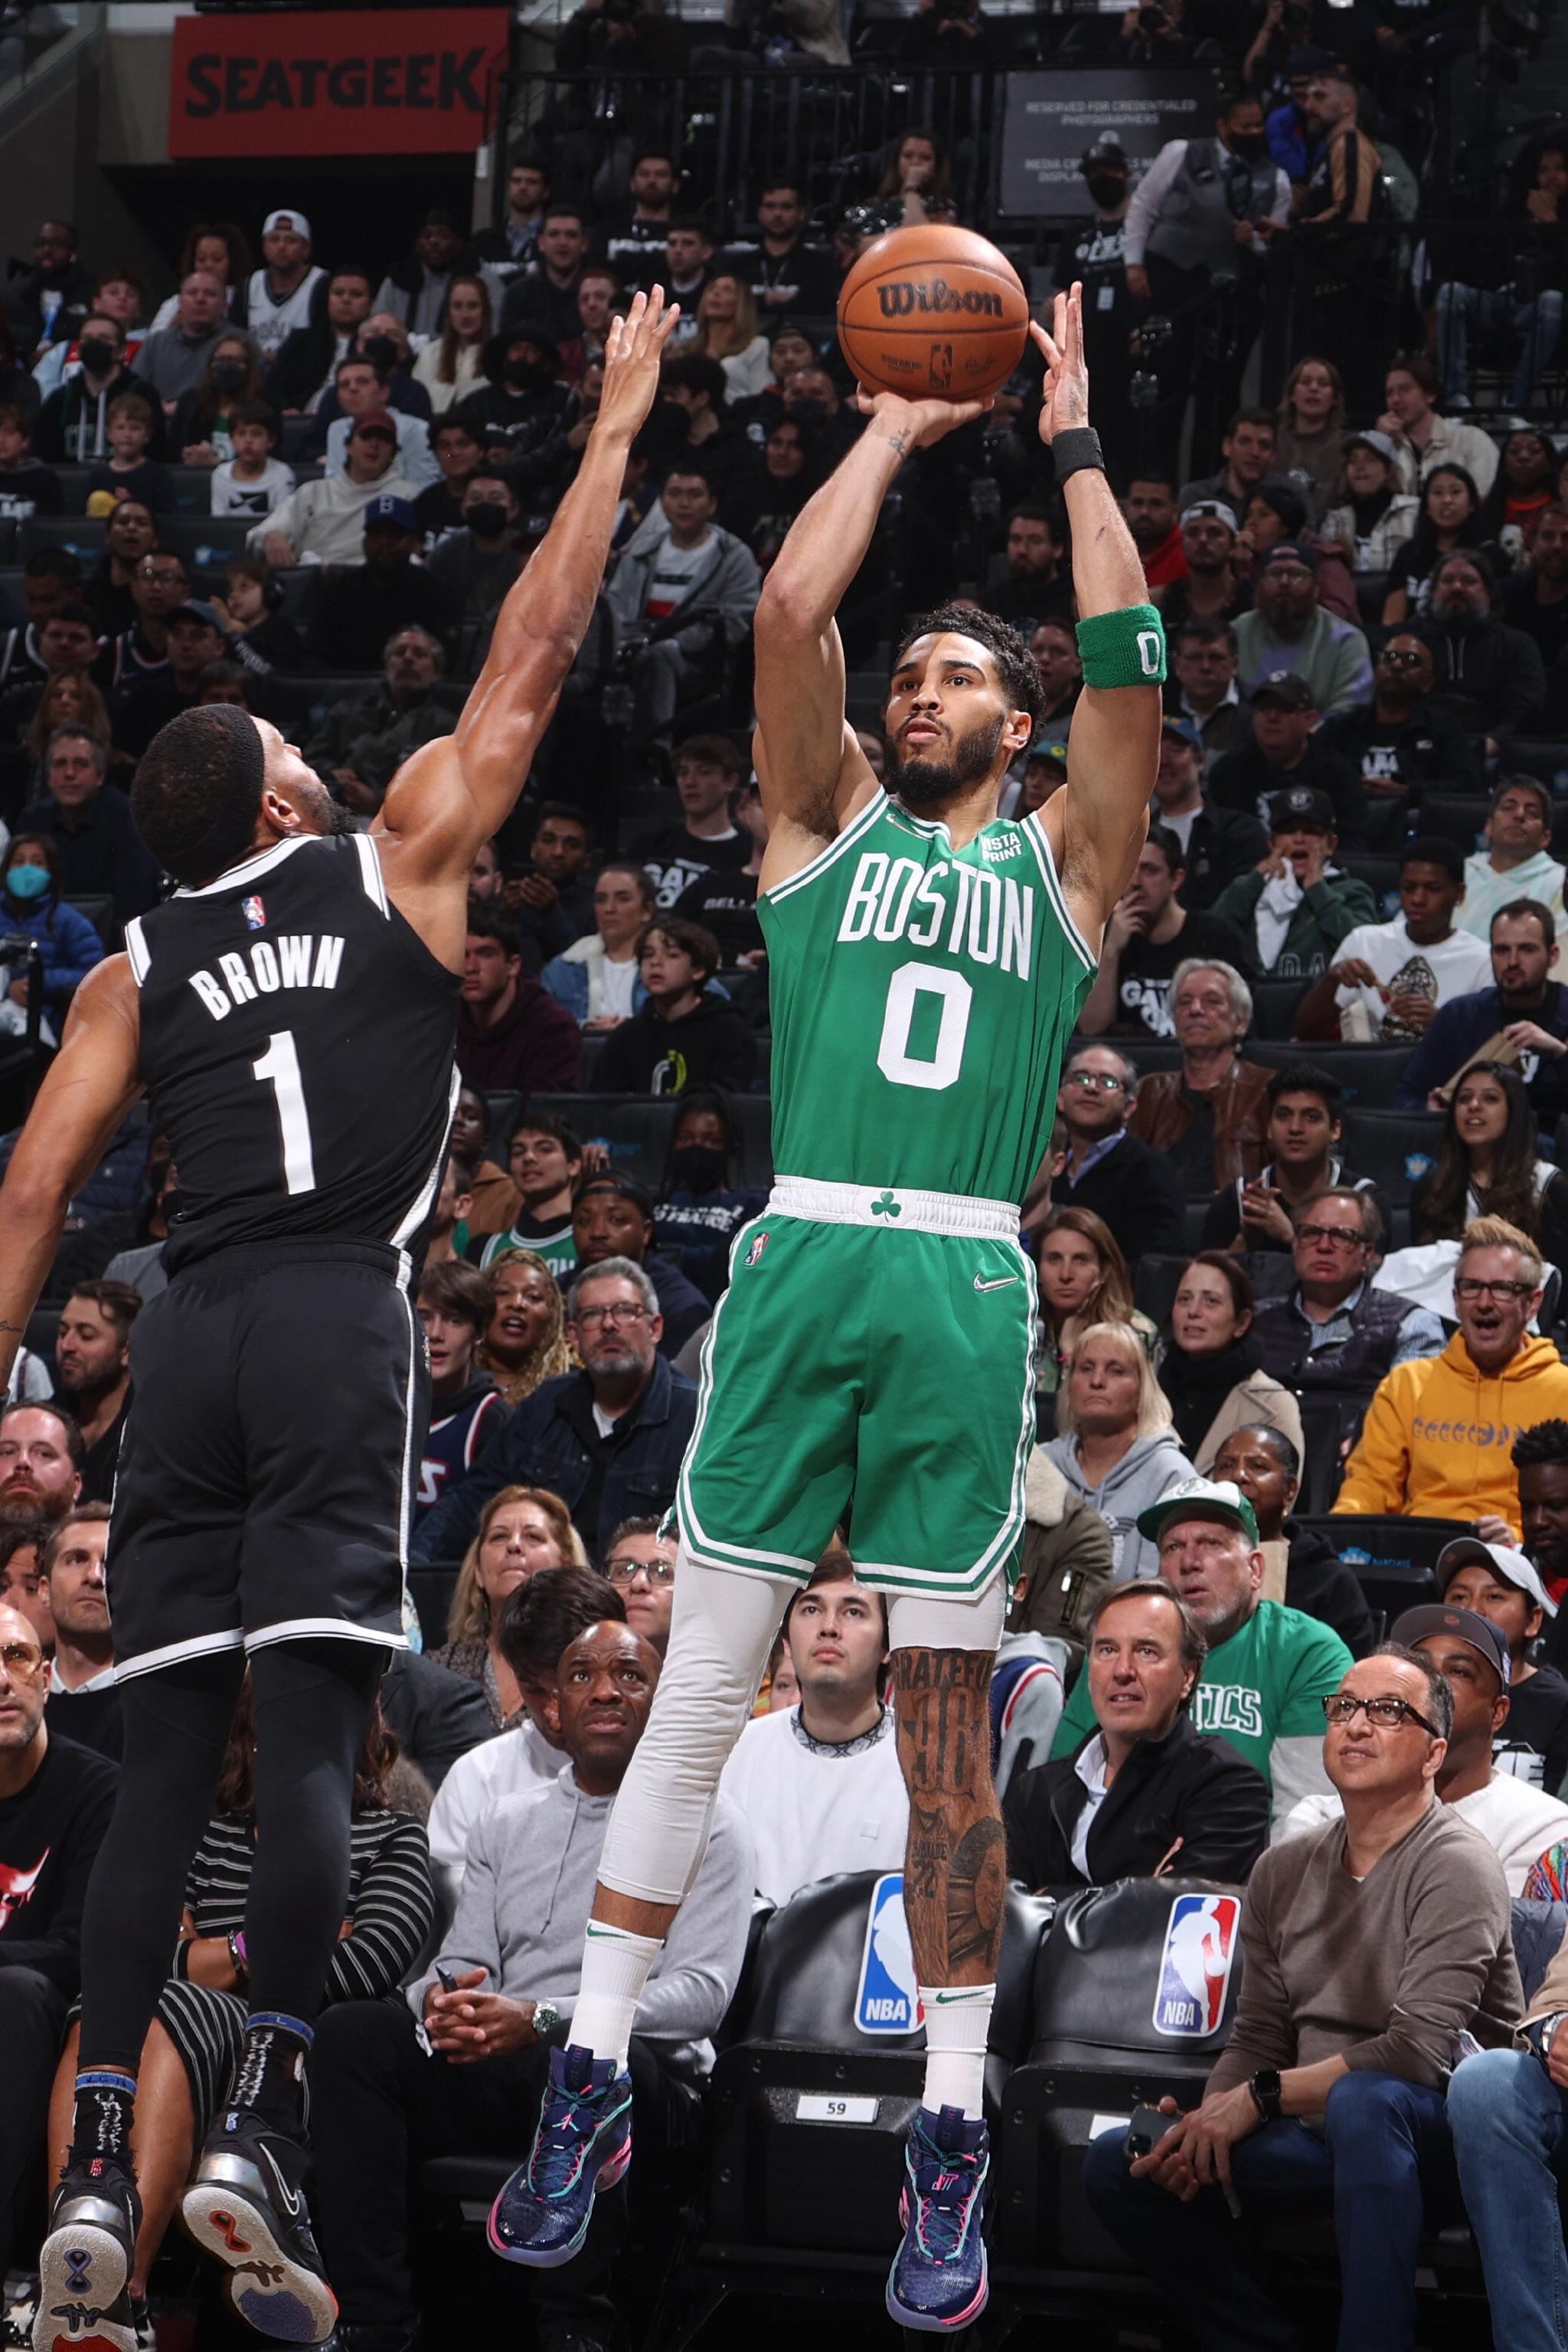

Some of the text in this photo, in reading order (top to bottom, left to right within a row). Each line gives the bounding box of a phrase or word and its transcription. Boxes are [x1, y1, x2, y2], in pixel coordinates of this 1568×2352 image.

[185, 47, 488, 117] SEATGEEK
[1026, 100, 1086, 113] RESERVED
[1088, 100, 1109, 112] FOR
[1061, 114, 1159, 126] PHOTOGRAPHERS
[877, 279, 1004, 318] Wilson
[1136, 631, 1161, 675] 0
[980, 831, 1021, 851] VISTA
[981, 843, 1022, 862] PRINT
[837, 852, 1034, 982] BOSTON
[188, 935, 345, 1021] BROWN
[877, 961, 973, 1090] 0
[252, 1030, 317, 1195] 1
[1190, 1682, 1263, 1738] TICS
[865, 1998, 906, 2021] NBA
[1164, 2001, 1195, 2027] NBA
[827, 2102, 846, 2115] 59
